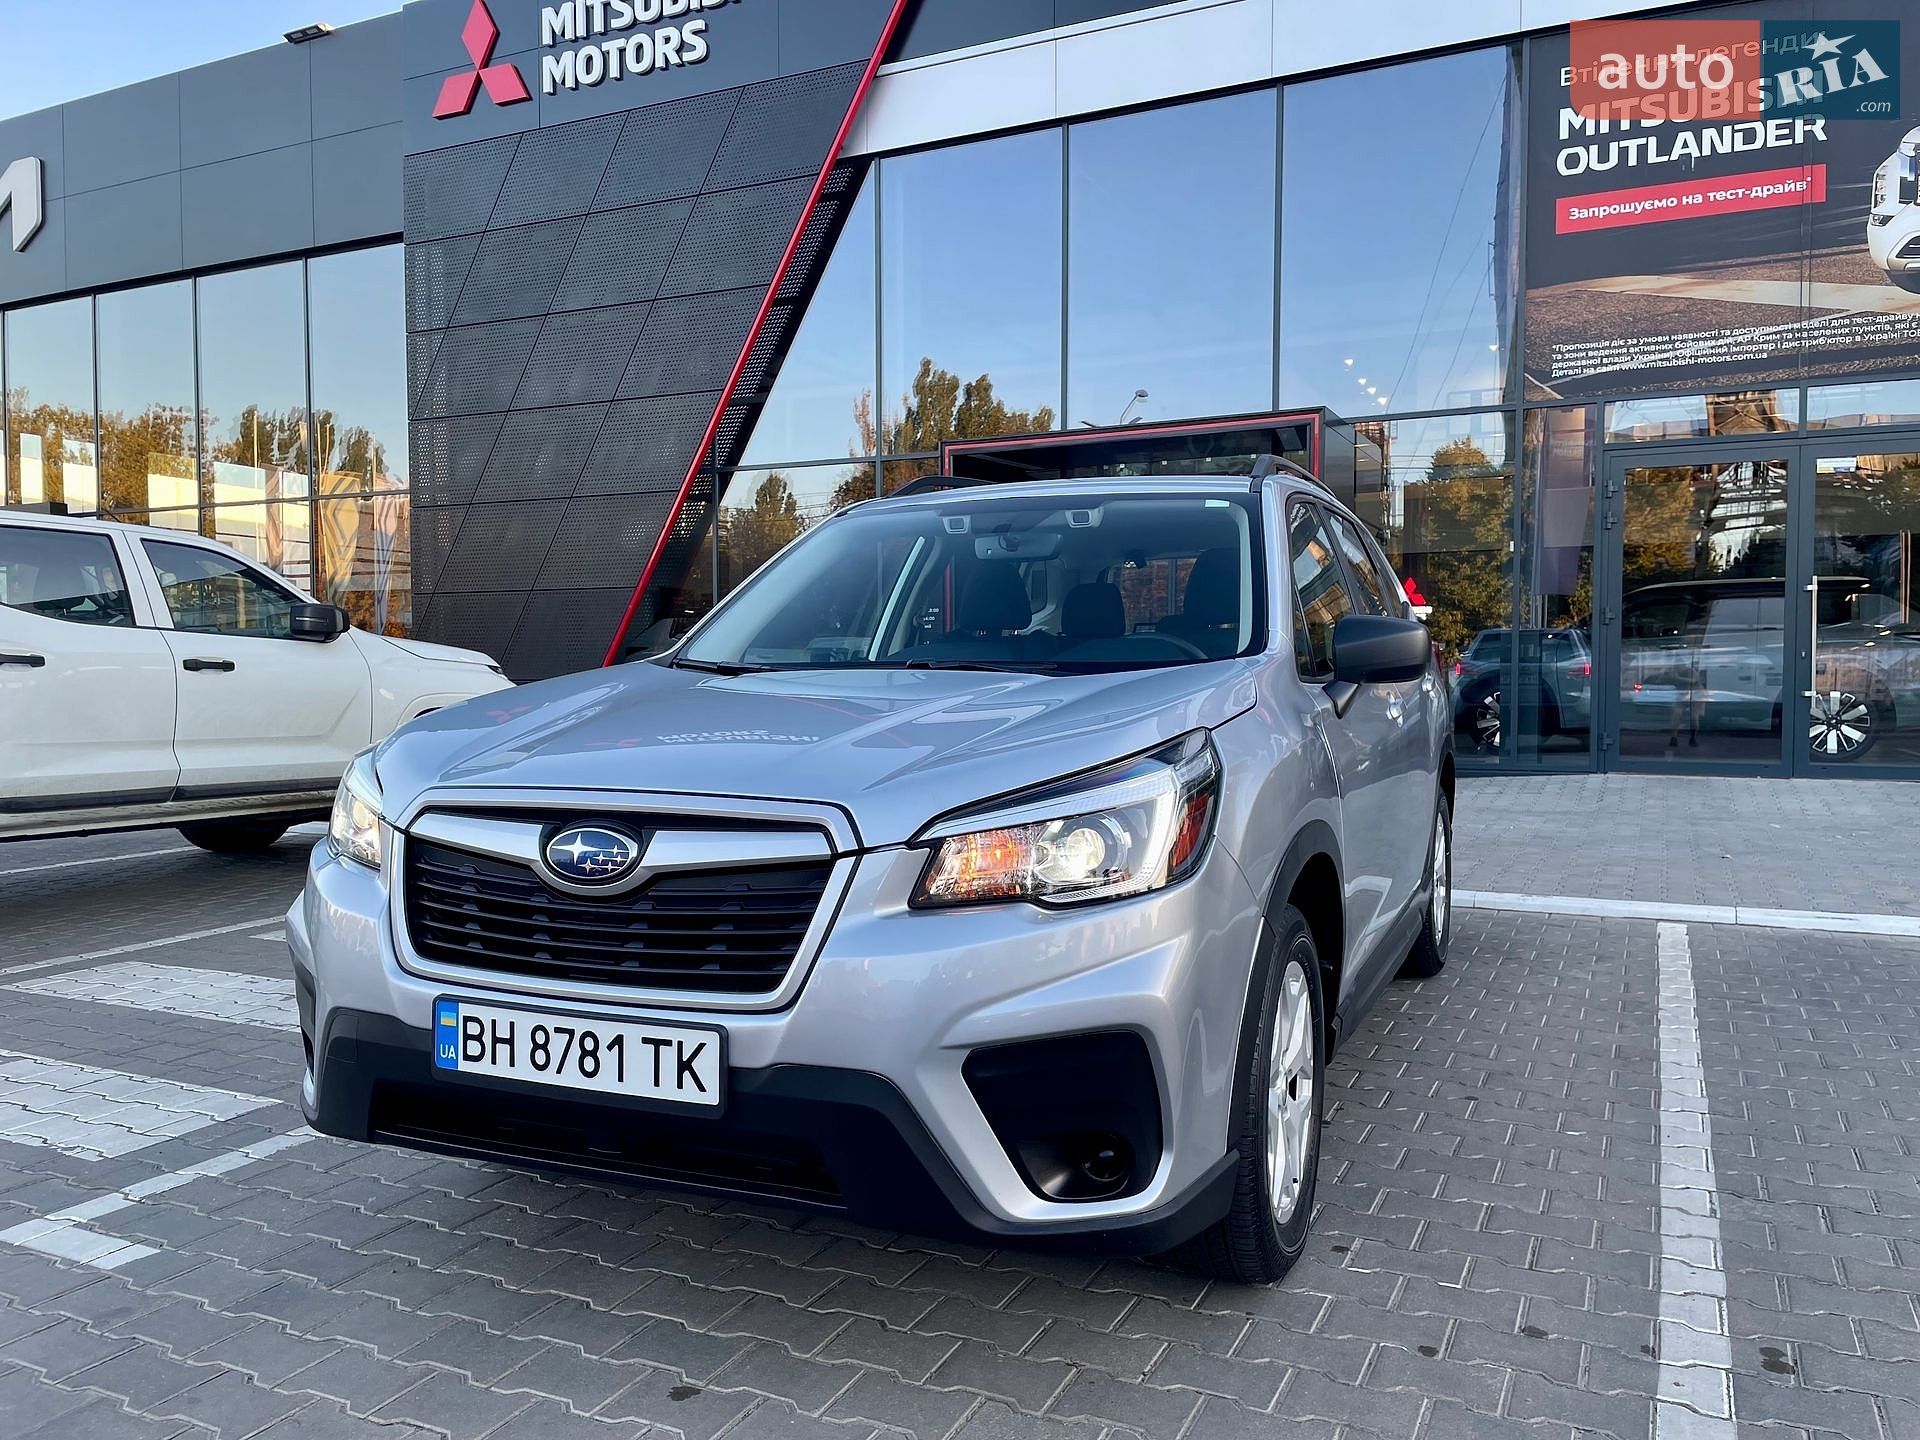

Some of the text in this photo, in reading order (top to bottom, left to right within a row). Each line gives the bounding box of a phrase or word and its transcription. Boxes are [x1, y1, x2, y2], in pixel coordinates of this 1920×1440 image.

[542, 19, 708, 94] MOTORS
[1556, 113, 1828, 176] OUTLANDER
[1568, 196, 1677, 220] Запрошуємо
[1682, 193, 1702, 206] на
[1587, 348, 1627, 357] ведення
[1629, 343, 1673, 353] активних
[1753, 332, 1780, 343] Крим
[1639, 335, 1669, 345] умови
[1671, 328, 1718, 341] наявності
[1830, 318, 1850, 328] для
[1552, 366, 1582, 378] Деталі
[1602, 355, 1632, 364] влади
[440, 1043, 457, 1060] UA
[462, 1014, 708, 1092] BH 8781 TK
